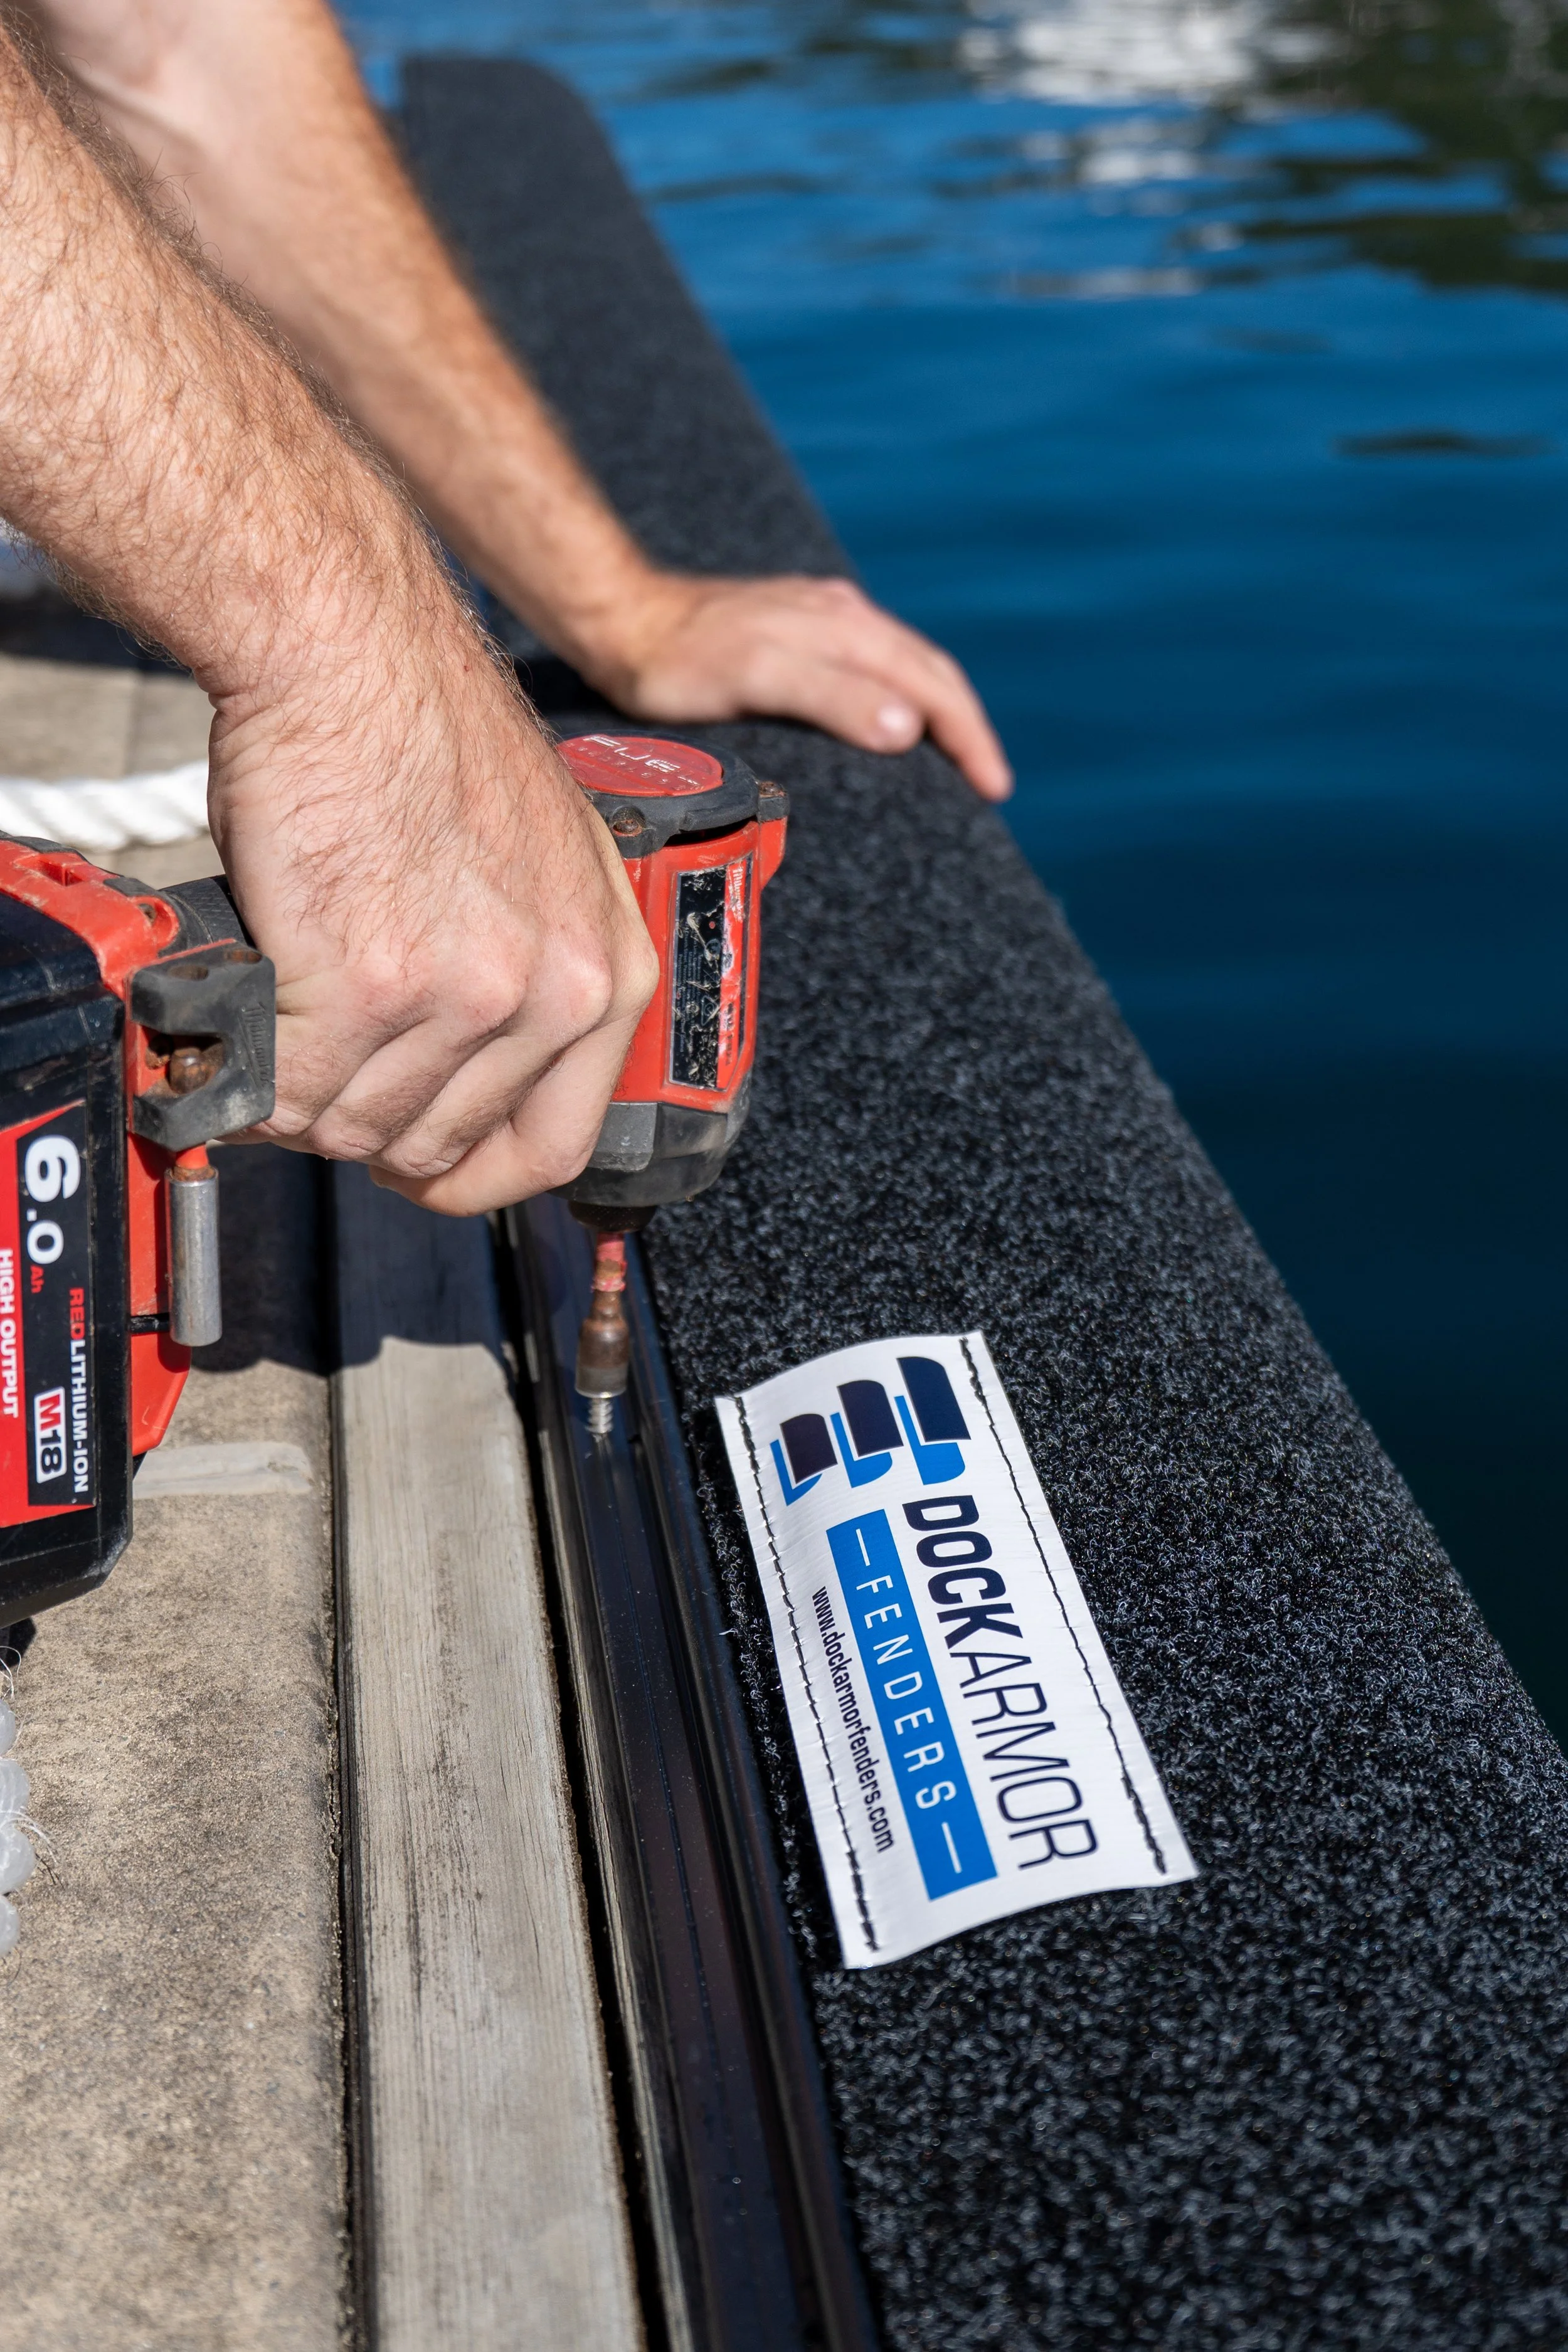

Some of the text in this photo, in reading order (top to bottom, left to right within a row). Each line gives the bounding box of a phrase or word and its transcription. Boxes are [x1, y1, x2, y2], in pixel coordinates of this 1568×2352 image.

[0, 1248, 18, 1418] HIGH OUTPUT
[37, 1393, 63, 1476] M18
[69, 1288, 89, 1493] REDLITHIUM-ION
[812, 1586, 896, 1853] www.dockarmorfenders.com
[856, 1575, 957, 1809] FENDERS
[902, 1495, 1099, 1870] DOCKARMOR
